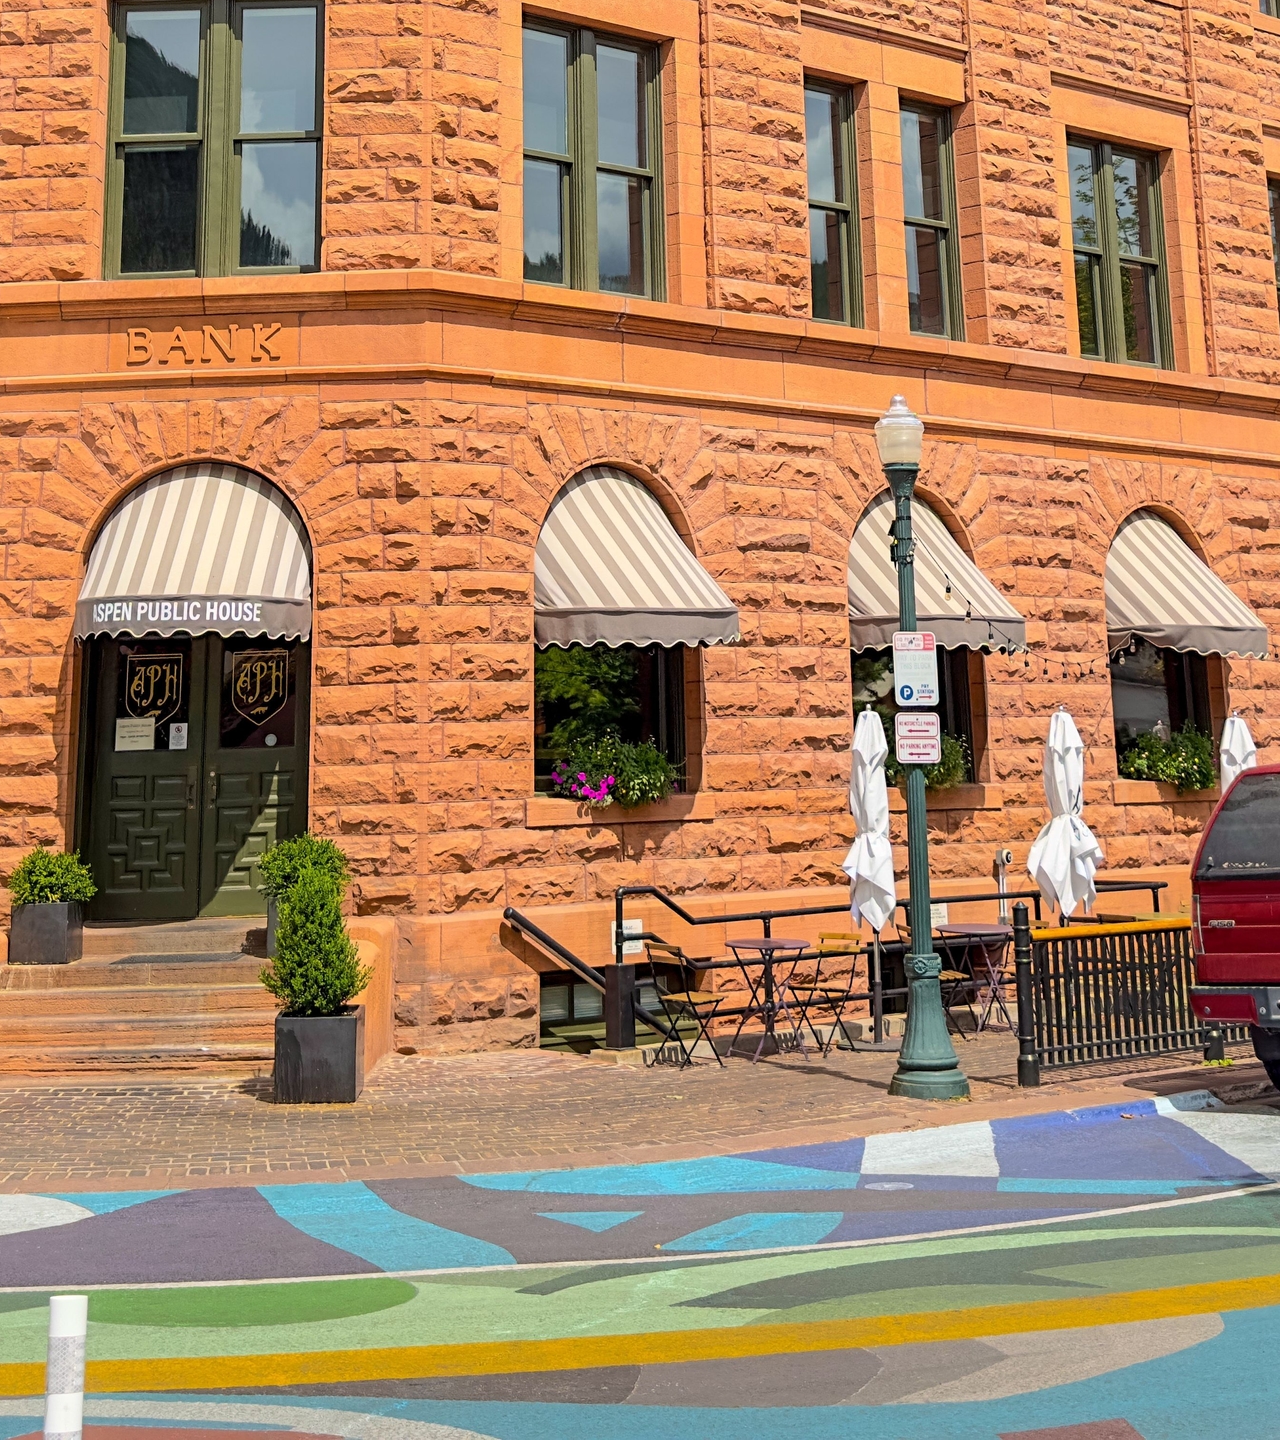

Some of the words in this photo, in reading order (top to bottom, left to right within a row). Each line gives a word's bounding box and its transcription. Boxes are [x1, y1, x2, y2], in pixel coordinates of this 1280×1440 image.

[126, 322, 282, 367] BANK
[93, 601, 133, 623] ASPEN
[136, 601, 201, 622] PUBLIC
[205, 601, 263, 623] HOUSE
[918, 653, 933, 661] PARK
[900, 662, 913, 670] THIS
[914, 662, 932, 670] BLOCK
